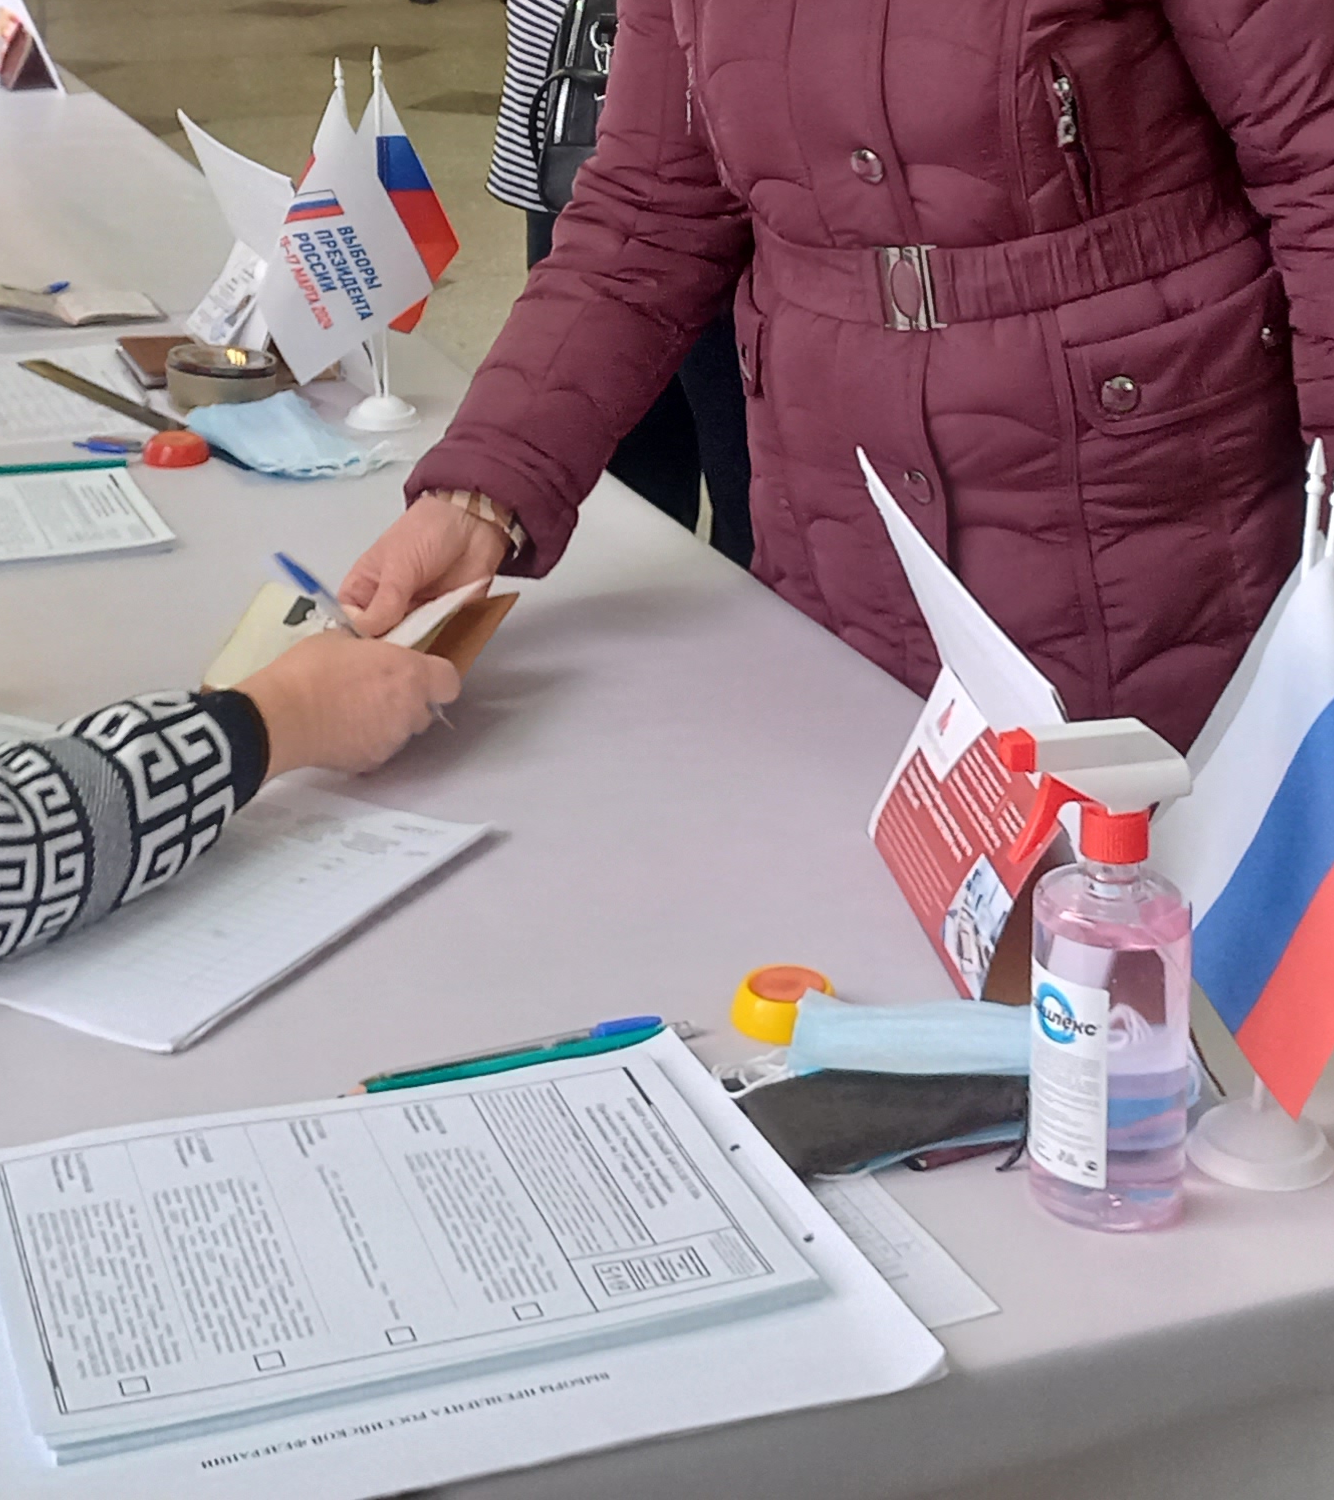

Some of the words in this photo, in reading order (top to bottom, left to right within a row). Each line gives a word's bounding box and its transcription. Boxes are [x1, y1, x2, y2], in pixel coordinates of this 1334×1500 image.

[290, 266, 321, 305] МАРТА
[292, 232, 338, 293] РОССИИ
[314, 229, 374, 321] ПРЕЗИДЕНТА
[336, 225, 382, 290] ВЫБОРЫ
